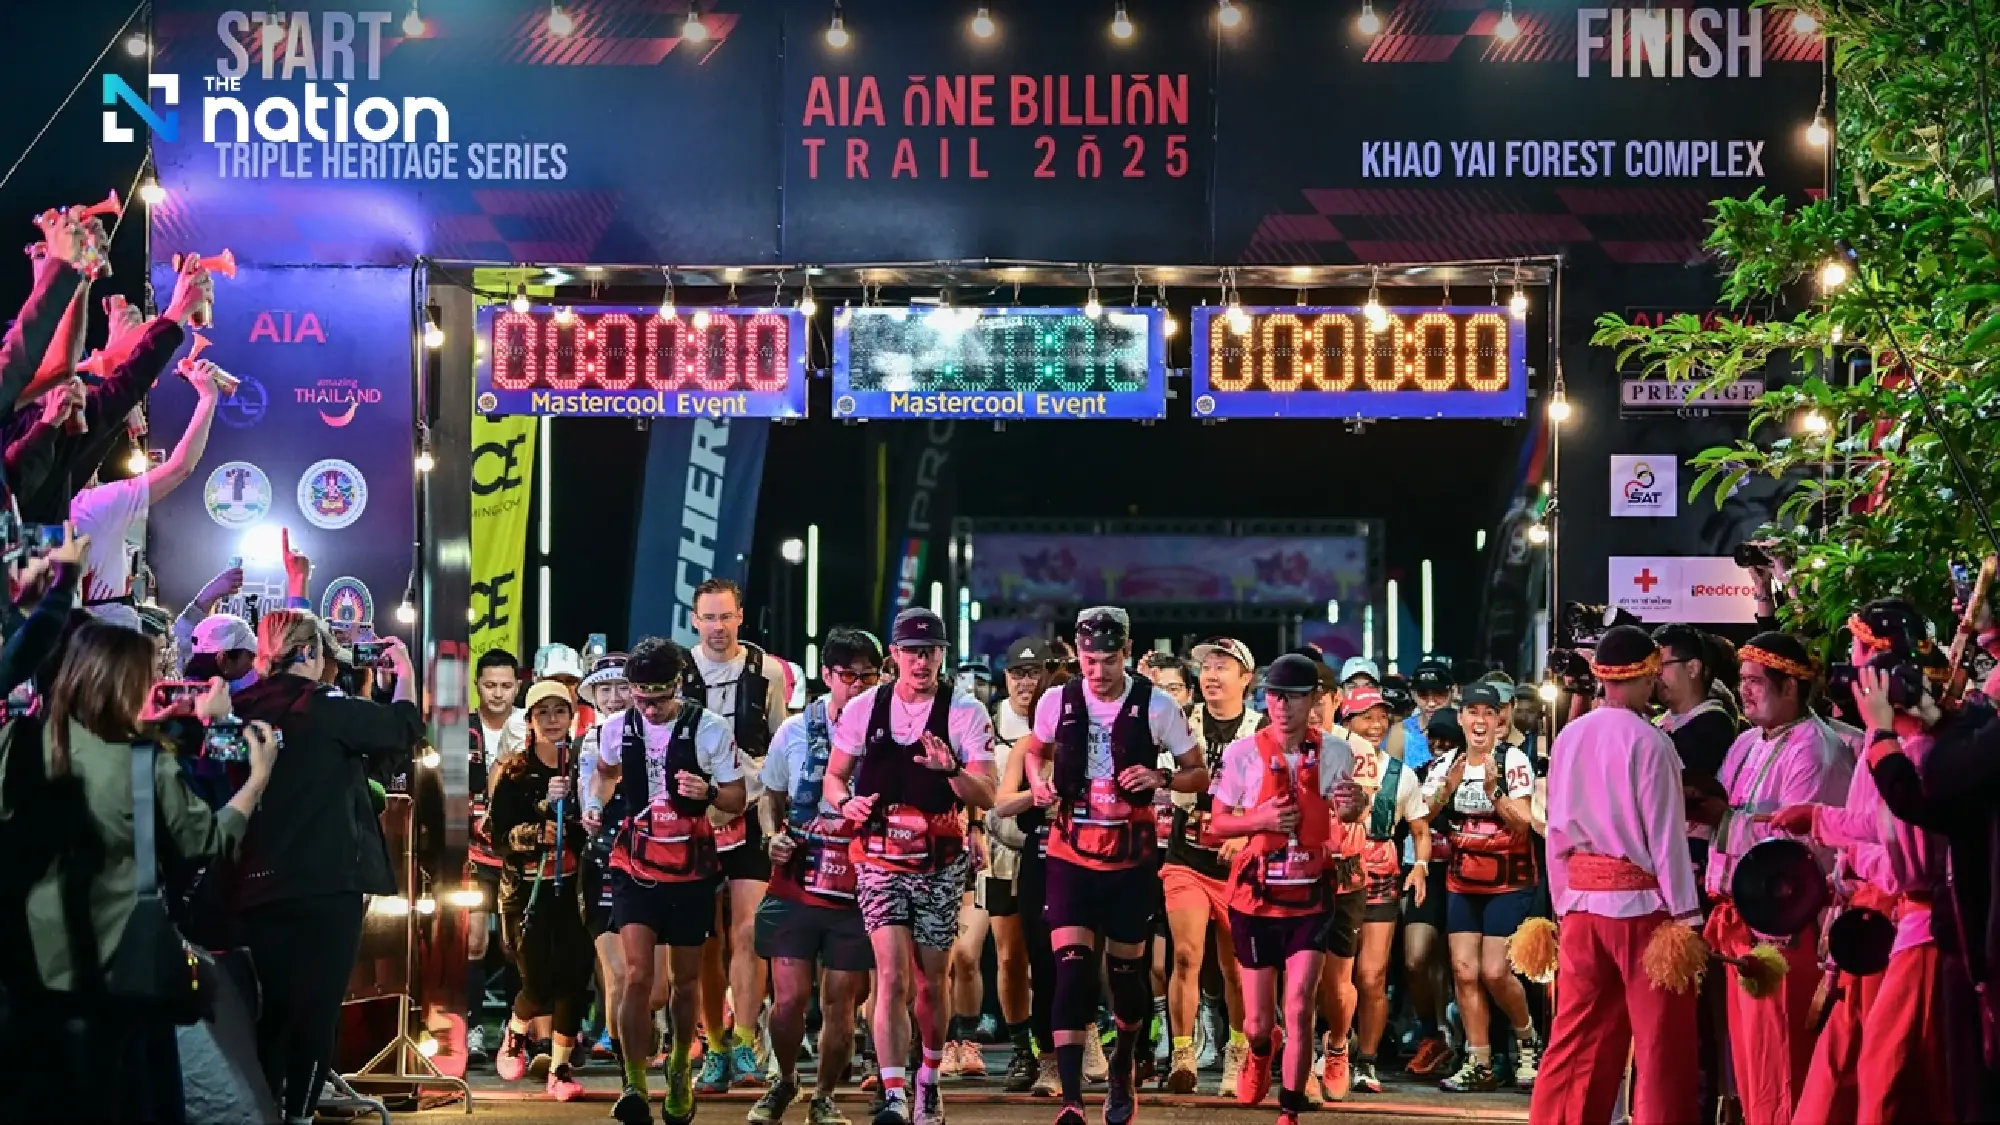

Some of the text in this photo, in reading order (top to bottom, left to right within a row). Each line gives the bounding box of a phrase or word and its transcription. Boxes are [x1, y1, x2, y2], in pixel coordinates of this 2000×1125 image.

[217, 10, 392, 82] START
[1577, 7, 1763, 79] FINISH
[802, 75, 887, 127] AIA
[215, 142, 568, 180] TRIPLE HERITAGE SERIES
[802, 137, 989, 179] TRAIL
[1361, 140, 1765, 178] KHAO YAI FOREST COMPLEX
[249, 312, 327, 344] AIA
[493, 312, 789, 391] 00:00:00
[1211, 312, 1507, 392] 00:00:00
[294, 389, 382, 404] THAILAND
[317, 378, 358, 389] amazing
[1632, 385, 1755, 401] PRESGE
[531, 391, 747, 413] Mastercool Event
[890, 391, 1106, 414] Mastercool Event
[1628, 488, 1662, 504] SAT
[1353, 753, 1378, 779] 25
[1507, 765, 1530, 791] 25
